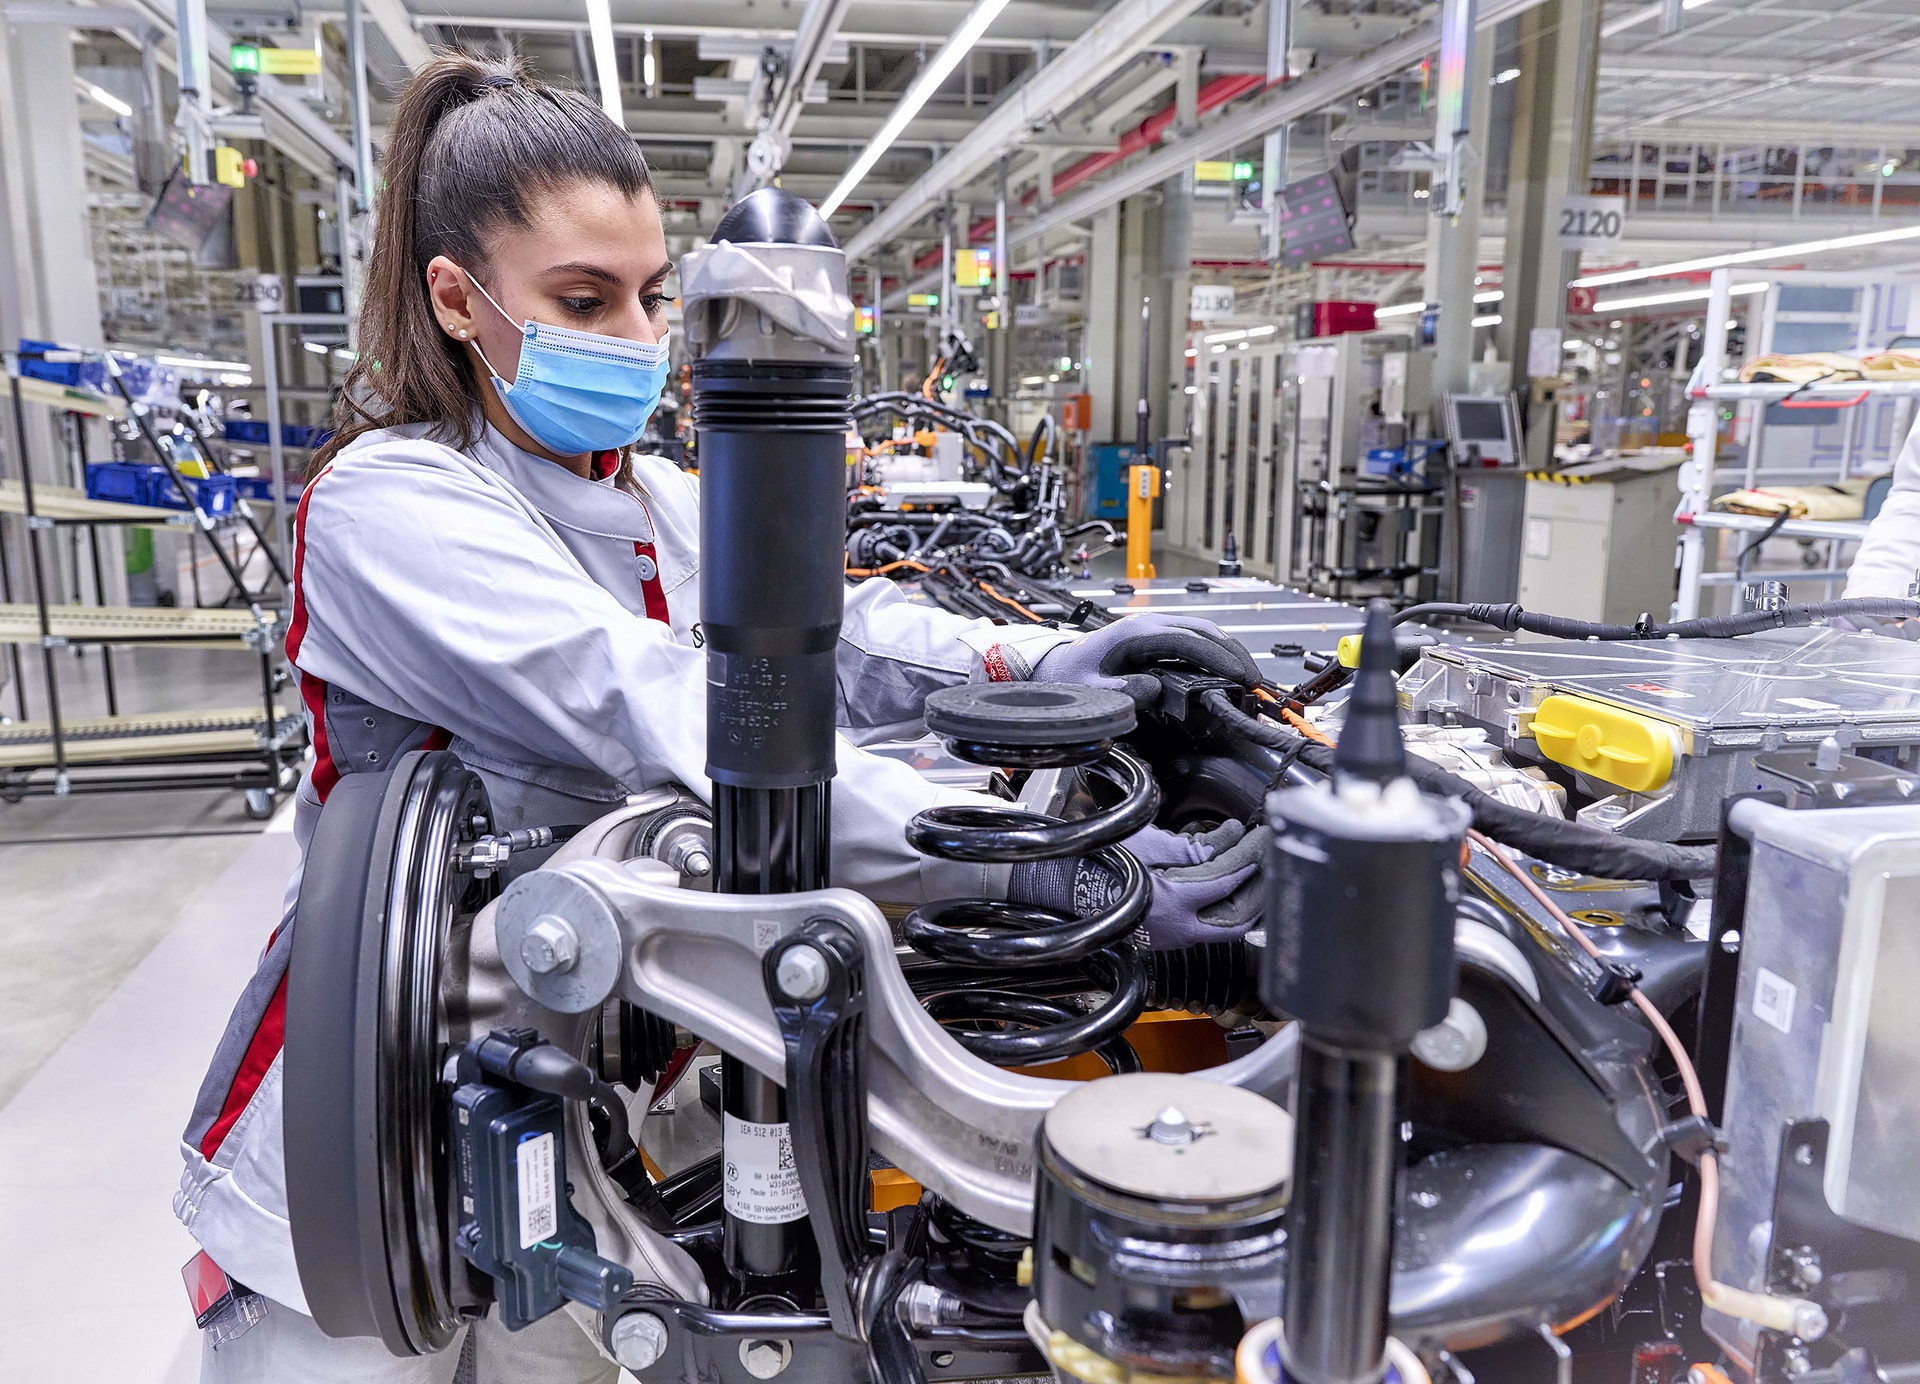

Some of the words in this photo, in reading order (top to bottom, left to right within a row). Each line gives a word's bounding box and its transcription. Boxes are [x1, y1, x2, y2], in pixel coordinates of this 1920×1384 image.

[1559, 208, 1621, 238] 2120
[1192, 294, 1233, 313] 2130
[740, 1124, 751, 1135] 1EA
[754, 1127, 766, 1137] 512
[769, 1127, 782, 1137] 013
[750, 1188, 766, 1197] Made
[770, 1188, 779, 1197] in
